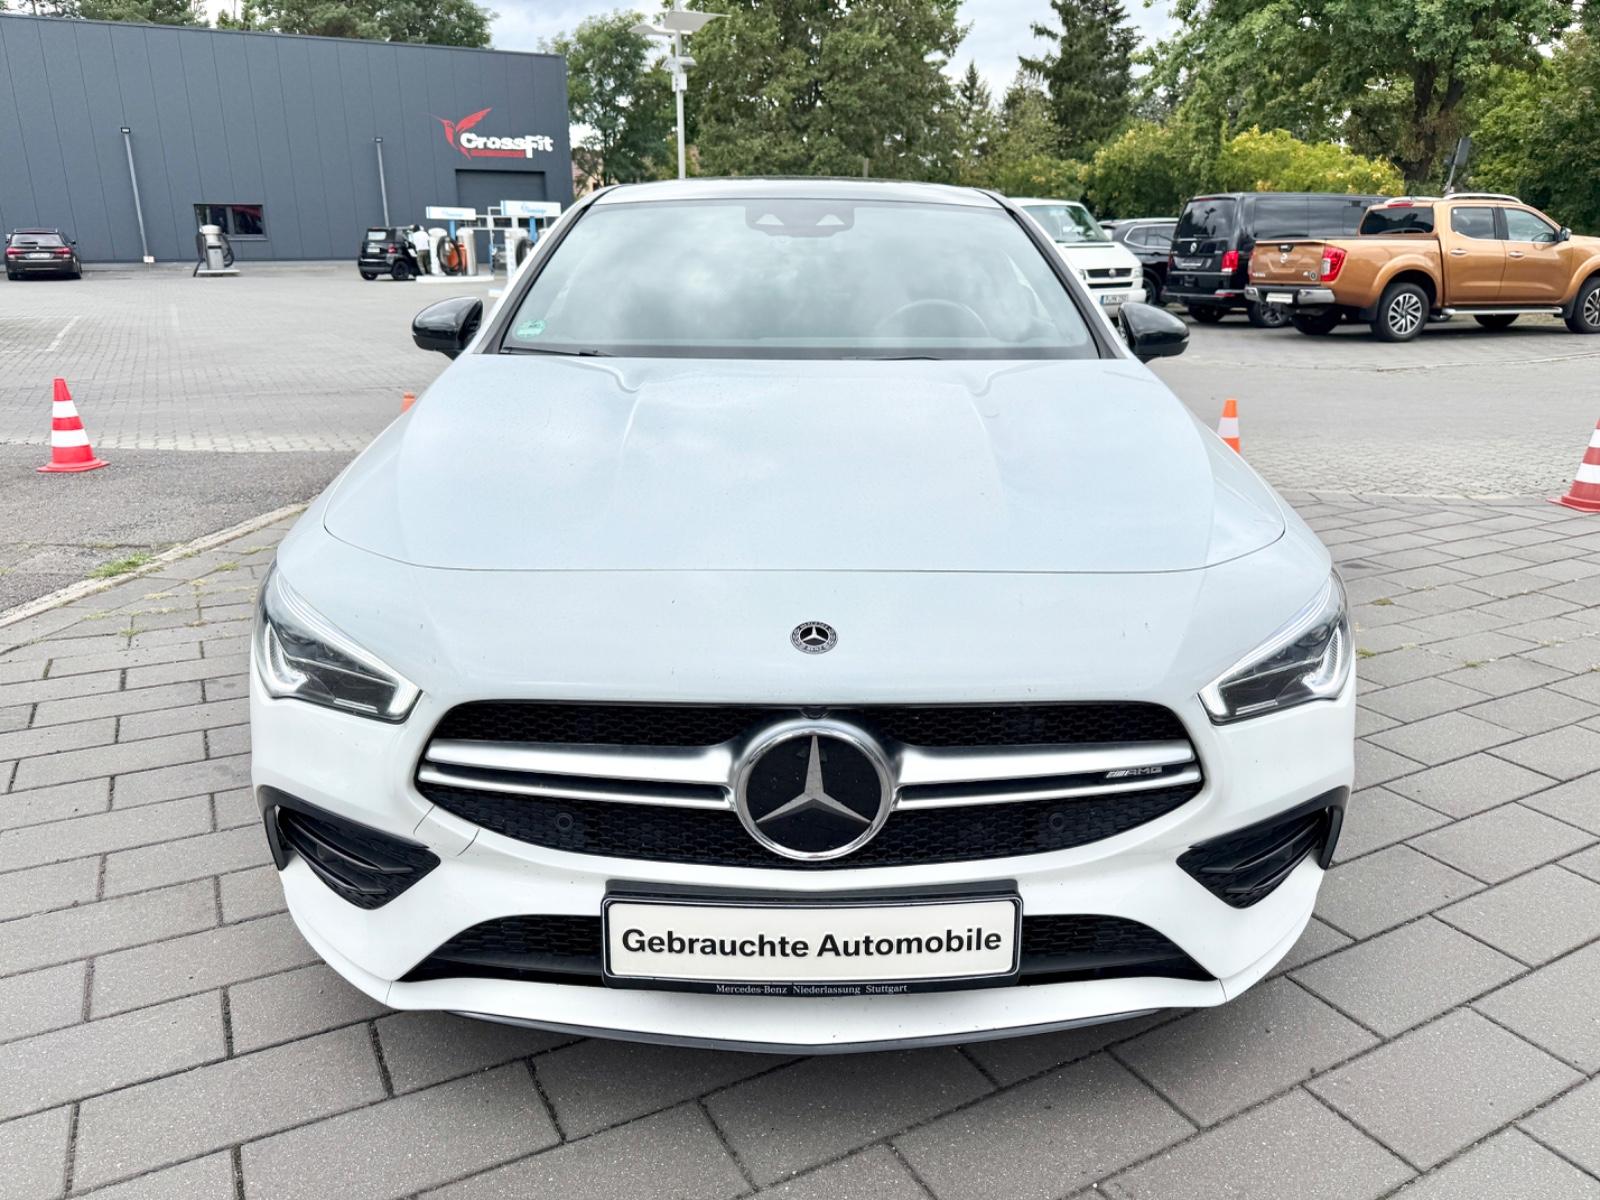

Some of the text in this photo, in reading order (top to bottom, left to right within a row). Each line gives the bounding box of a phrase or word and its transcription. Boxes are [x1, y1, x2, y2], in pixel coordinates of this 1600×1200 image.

[622, 927, 1002, 957] Gebrauchte Automobile
[716, 984, 908, 996] Mercedes-Benz Niederlassung Stuttgart
